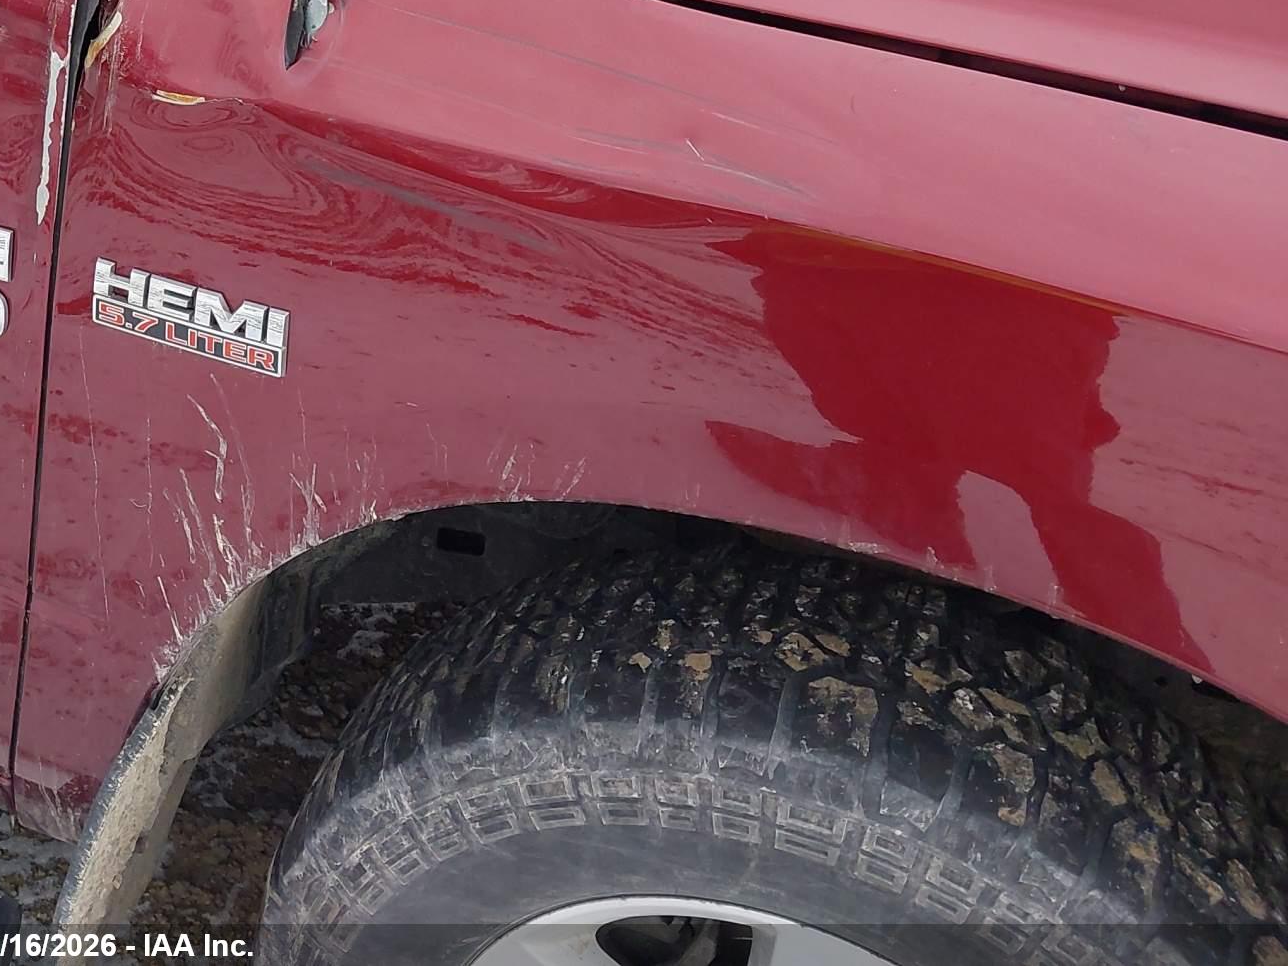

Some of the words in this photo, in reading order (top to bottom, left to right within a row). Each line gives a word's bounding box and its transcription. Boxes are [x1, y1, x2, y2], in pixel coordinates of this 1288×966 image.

[93, 257, 289, 348] HEMI
[98, 301, 158, 333] 5.7
[165, 321, 275, 372] LITER
